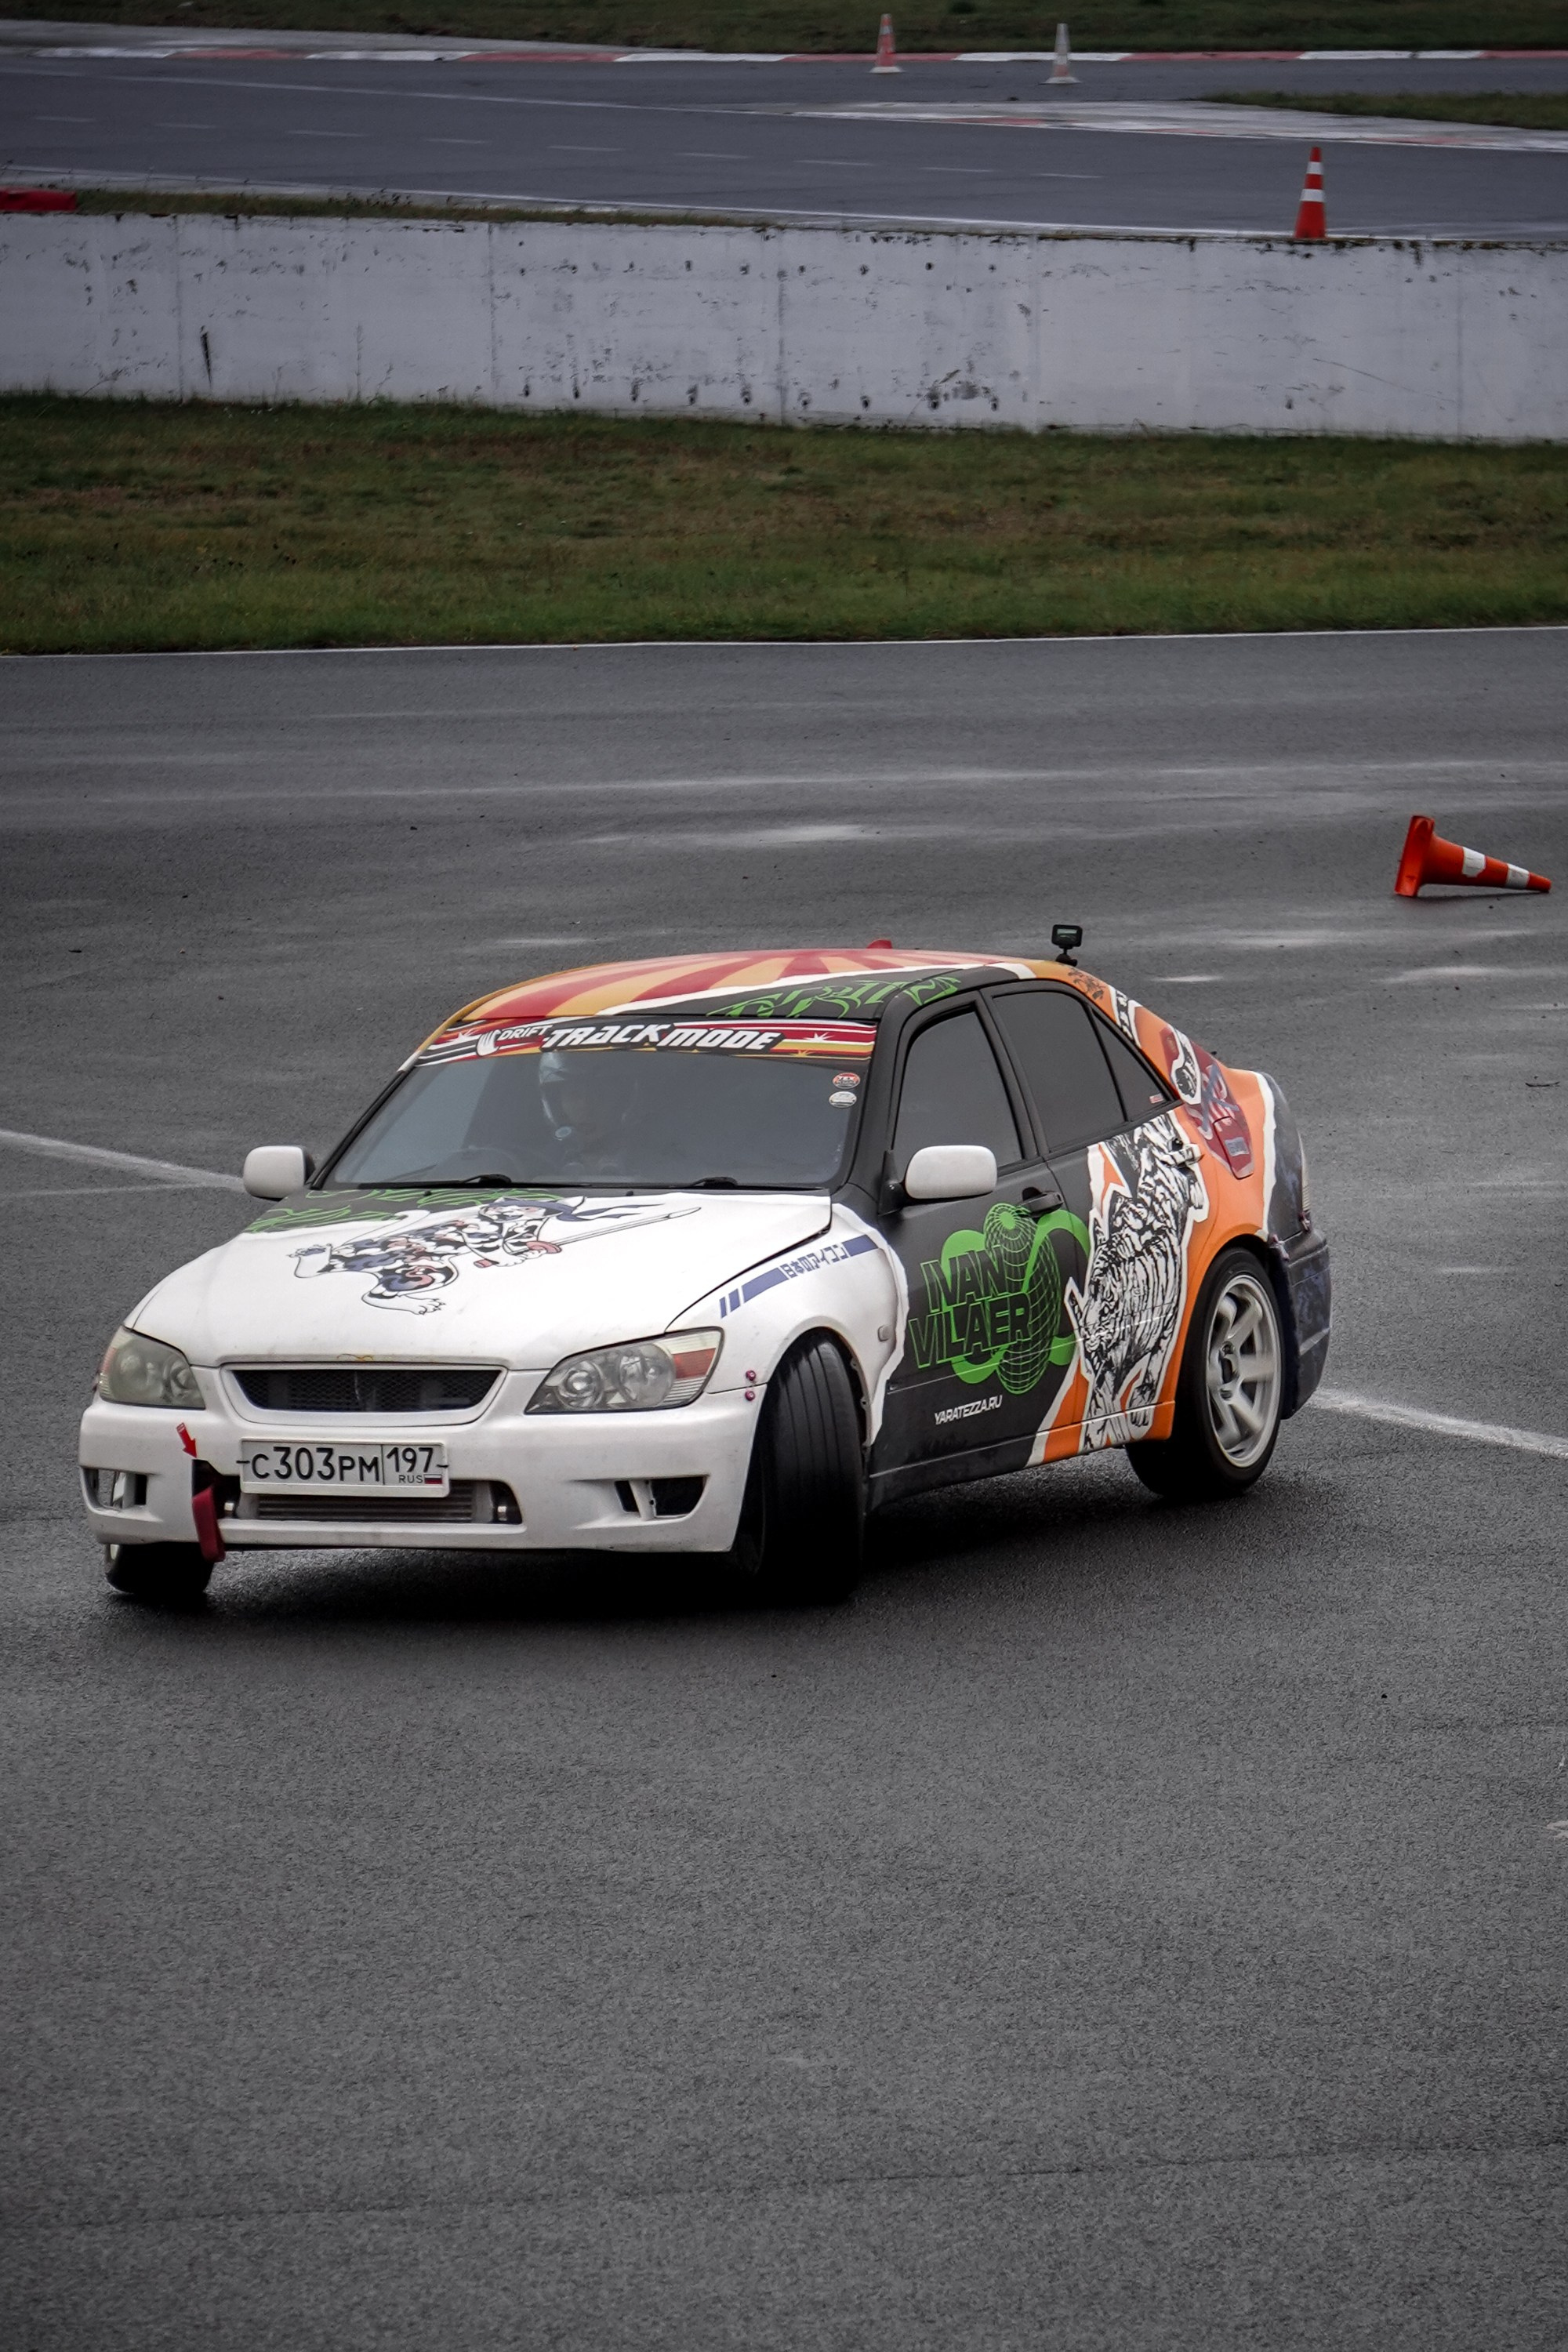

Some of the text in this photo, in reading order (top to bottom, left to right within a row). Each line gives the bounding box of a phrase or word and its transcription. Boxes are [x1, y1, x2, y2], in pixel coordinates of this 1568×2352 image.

[497, 1025, 554, 1041] DRIFT
[920, 1245, 1008, 1312] IVAN
[909, 1292, 1032, 1369] VILAER
[935, 1395, 1003, 1425] YARATEZZA.RU
[387, 1447, 434, 1472] 197
[398, 1474, 423, 1483] RUS
